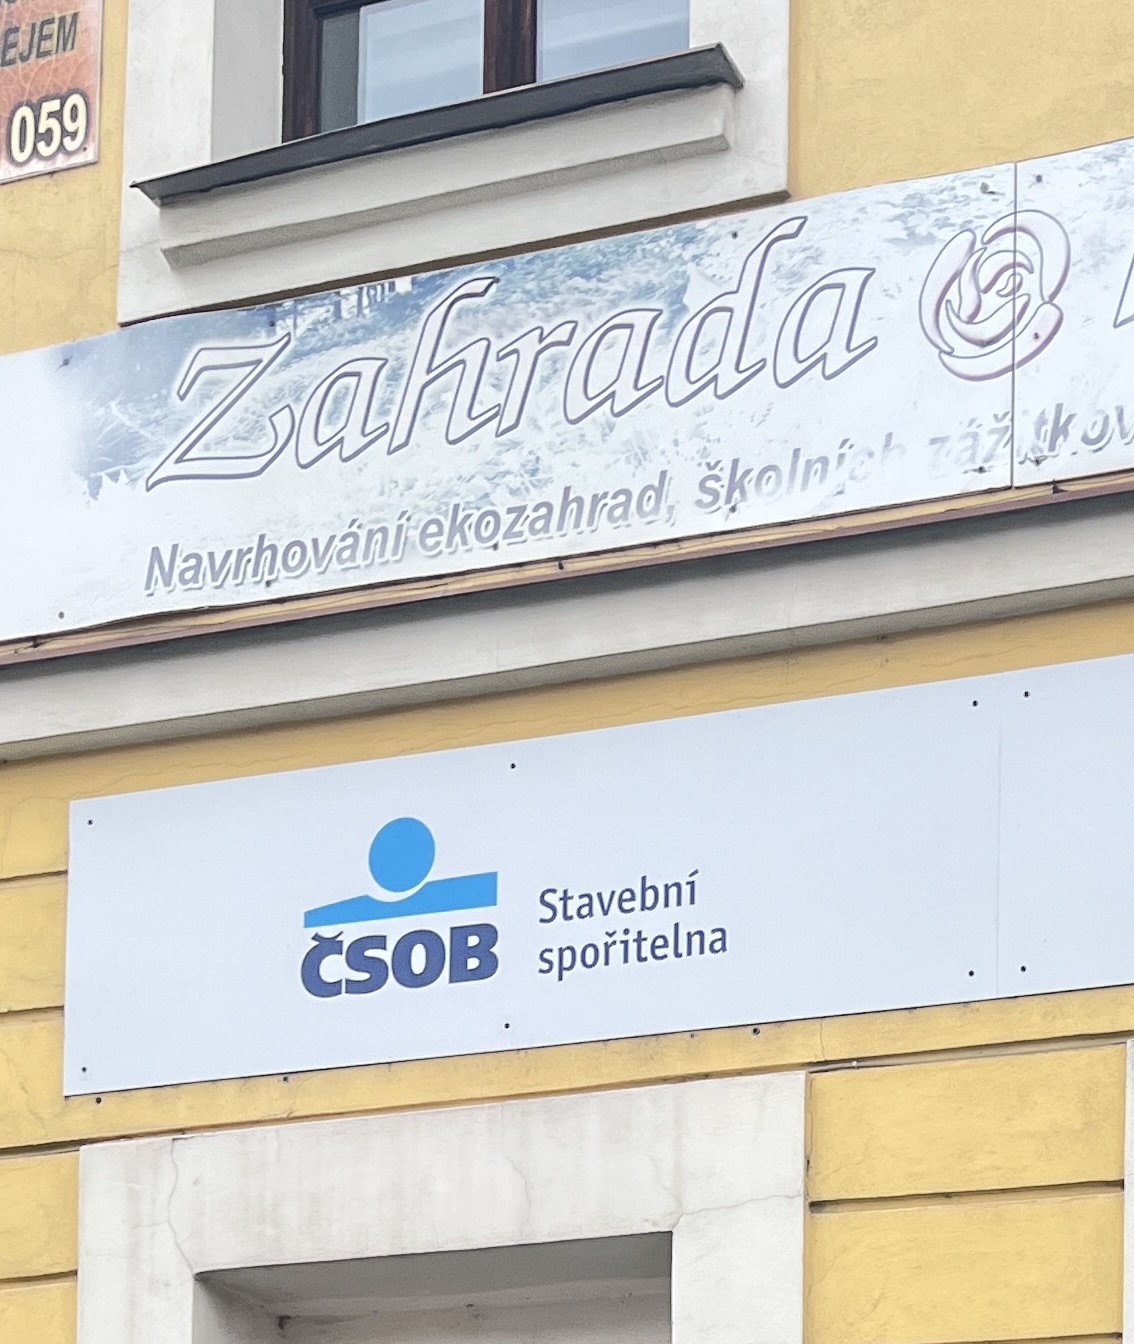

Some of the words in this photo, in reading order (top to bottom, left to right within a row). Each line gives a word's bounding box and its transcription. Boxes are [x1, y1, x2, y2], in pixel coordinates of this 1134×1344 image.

[8, 91, 89, 166] 059
[146, 216, 878, 492] Zahrada
[144, 510, 410, 593] Navrhování
[417, 470, 677, 555] ekozahrad,
[538, 869, 700, 924] Stavební
[301, 922, 499, 998] ČSOB
[538, 923, 729, 981] spořitelna
